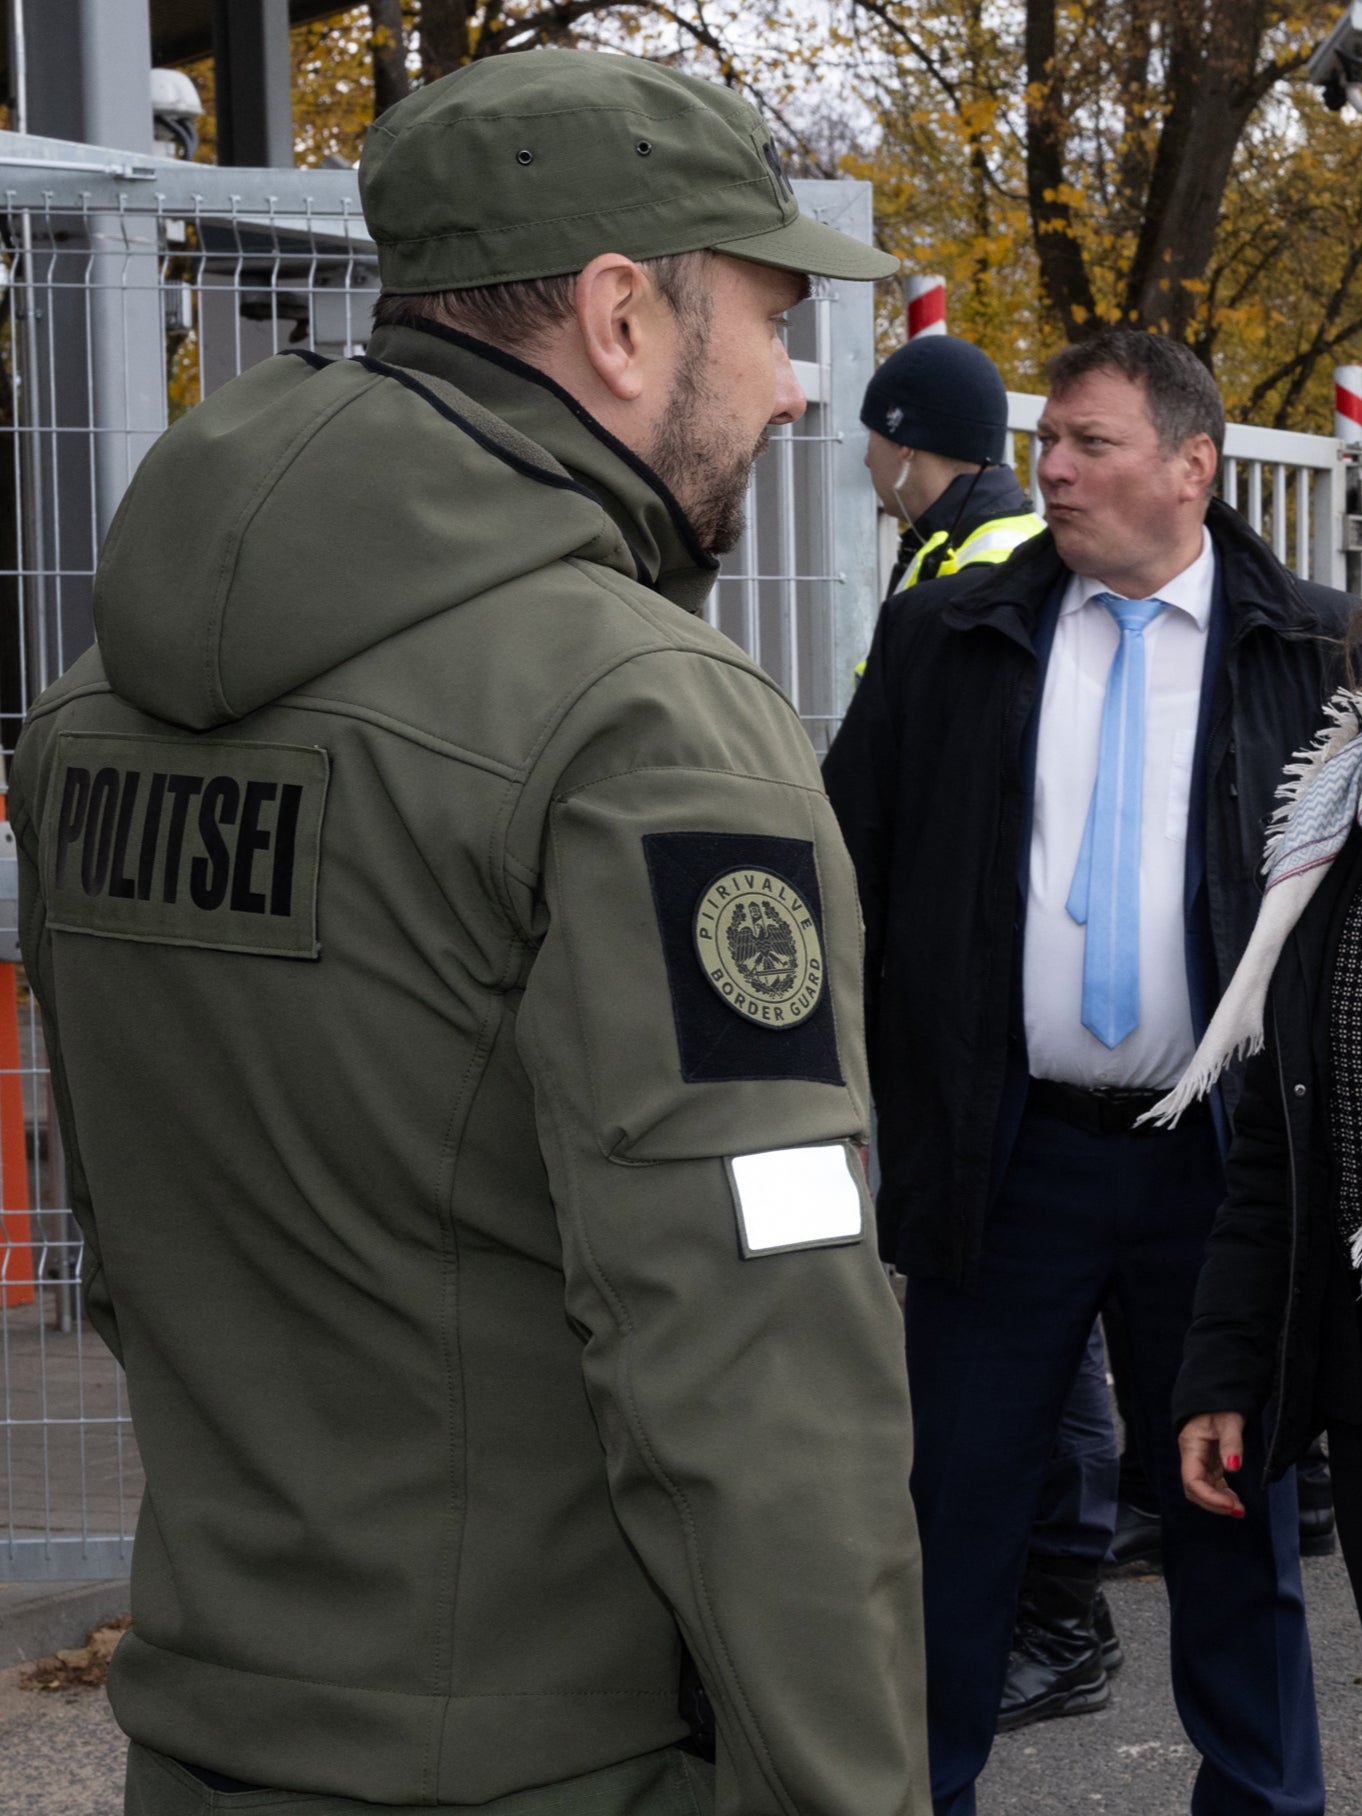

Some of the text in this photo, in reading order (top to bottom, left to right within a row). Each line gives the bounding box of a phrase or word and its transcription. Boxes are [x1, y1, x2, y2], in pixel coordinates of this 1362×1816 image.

[56, 767, 303, 917] POLITSEI
[699, 874, 813, 940] PIIRIVALVE
[711, 957, 821, 1021] BORDER GUARD
